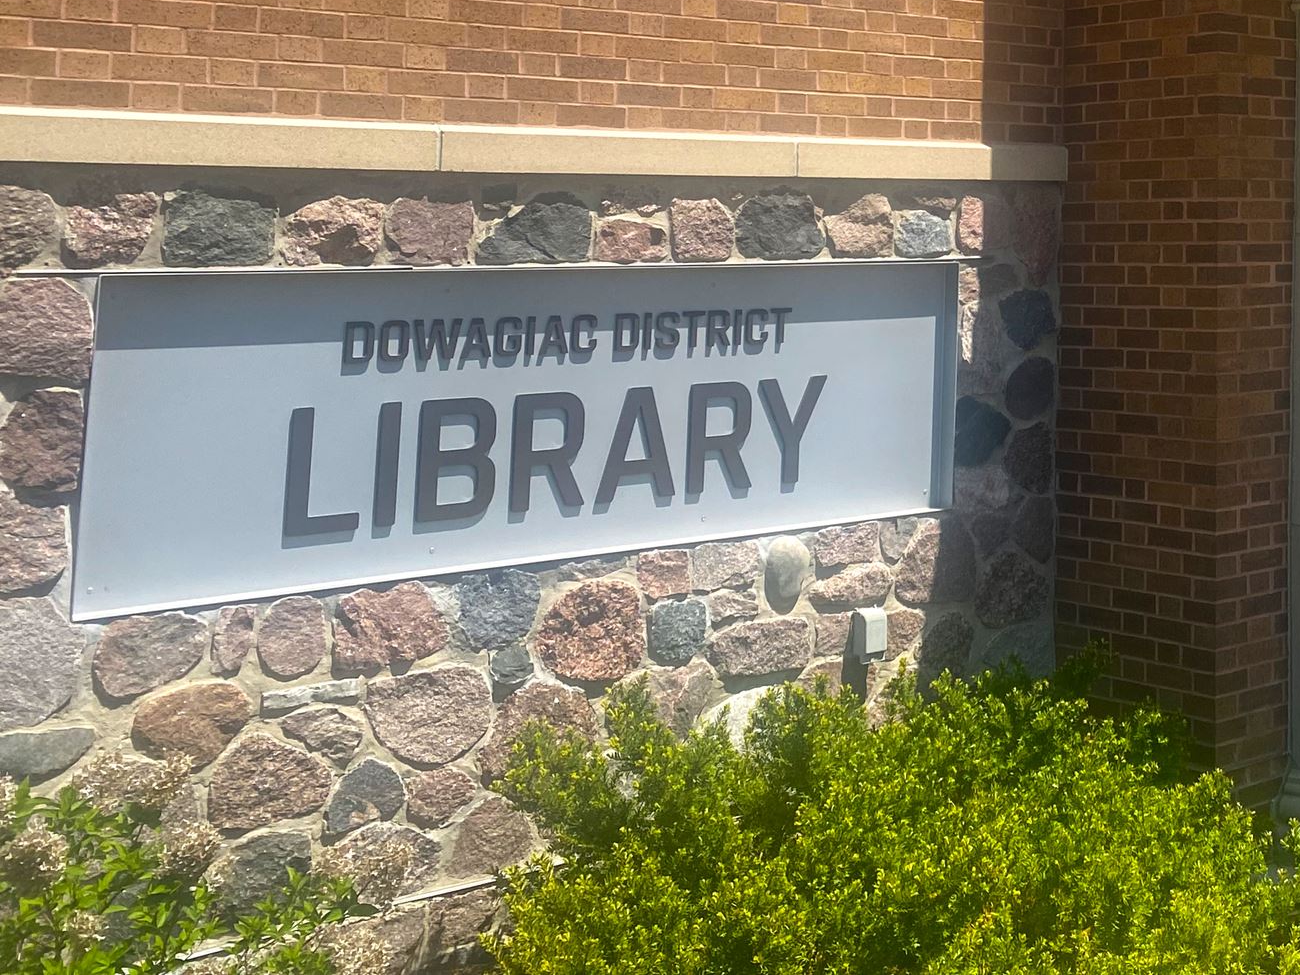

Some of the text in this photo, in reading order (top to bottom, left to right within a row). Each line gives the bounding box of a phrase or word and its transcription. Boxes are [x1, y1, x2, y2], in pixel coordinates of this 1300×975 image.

[342, 307, 793, 365] DOWAGIAC DISTRICT
[283, 374, 828, 539] LIBRARY
